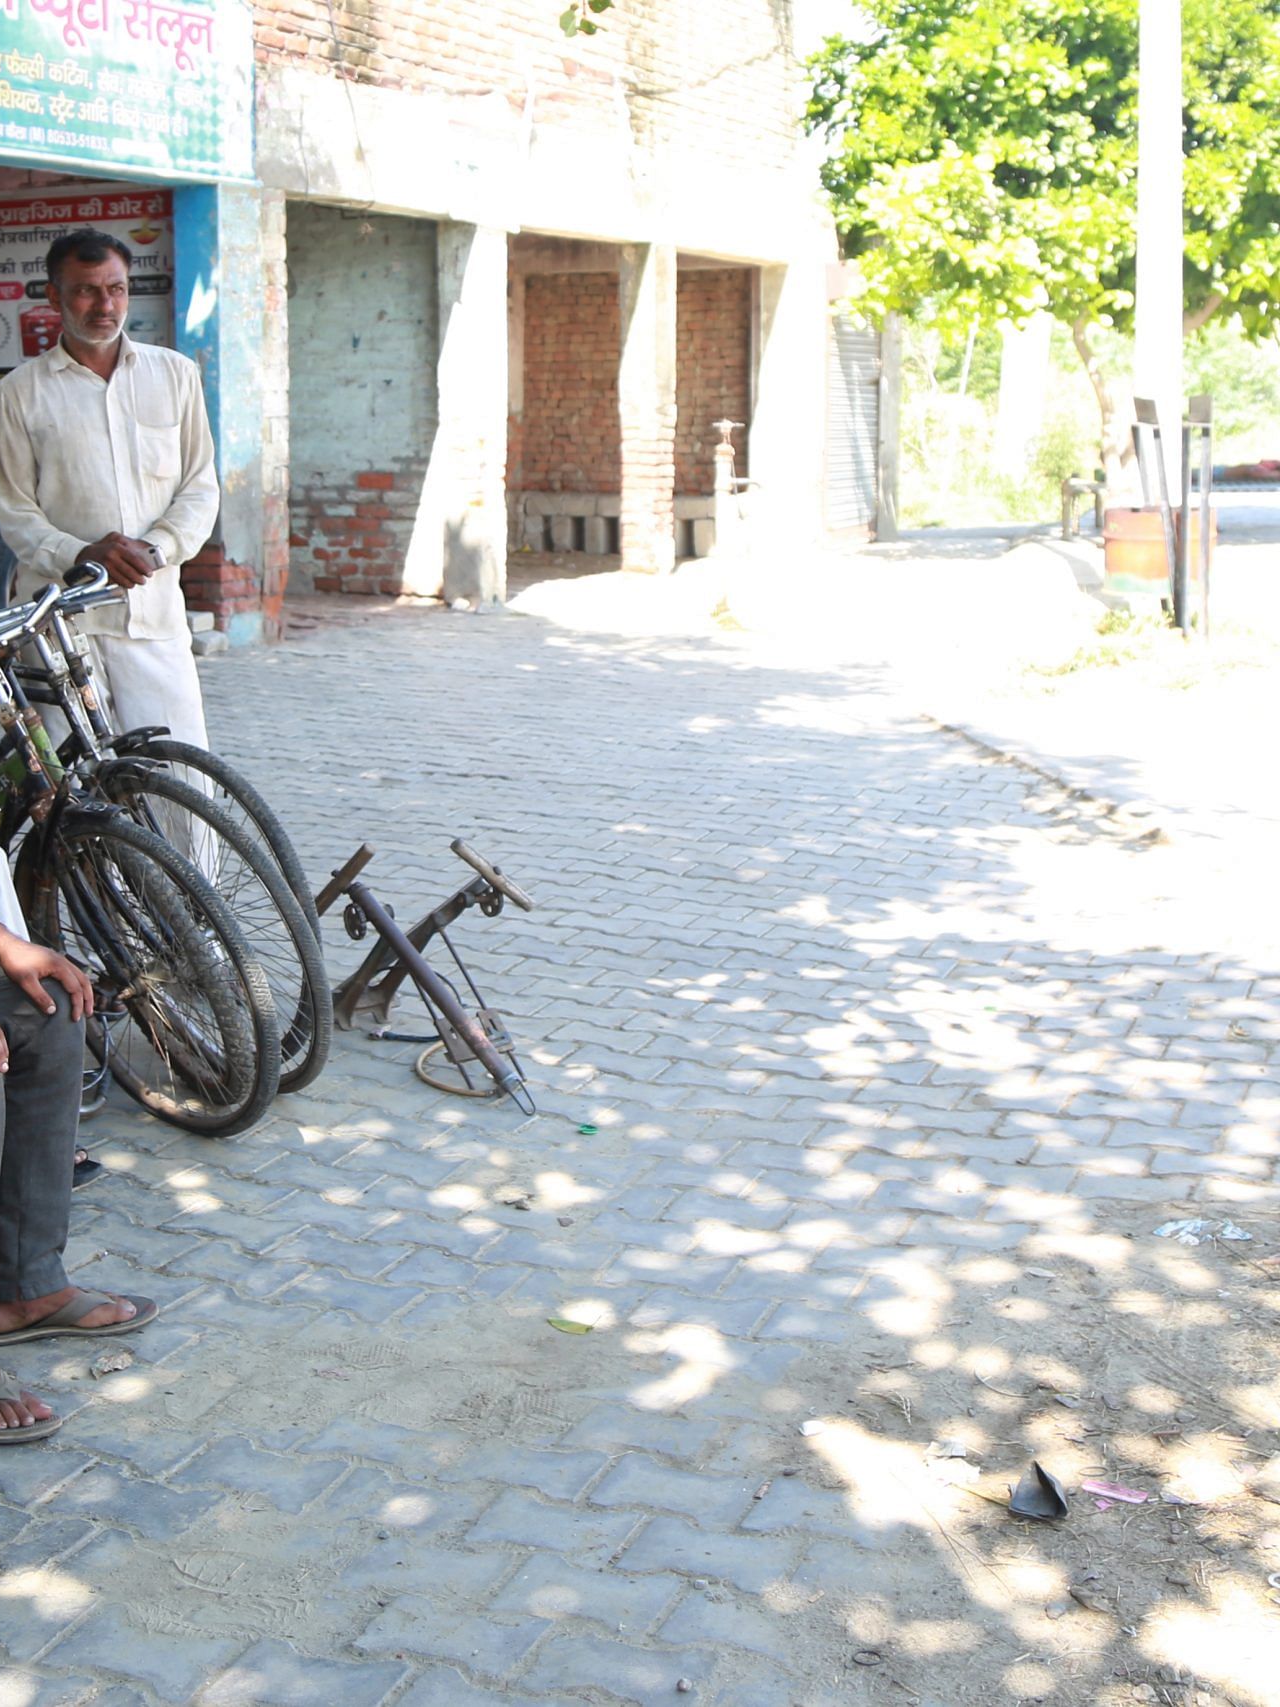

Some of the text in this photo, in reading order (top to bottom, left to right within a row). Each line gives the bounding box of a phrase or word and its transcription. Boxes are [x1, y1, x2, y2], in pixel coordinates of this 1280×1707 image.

[77, 197, 103, 217] की
[107, 195, 143, 216] ओर
[146, 194, 164, 214] से
